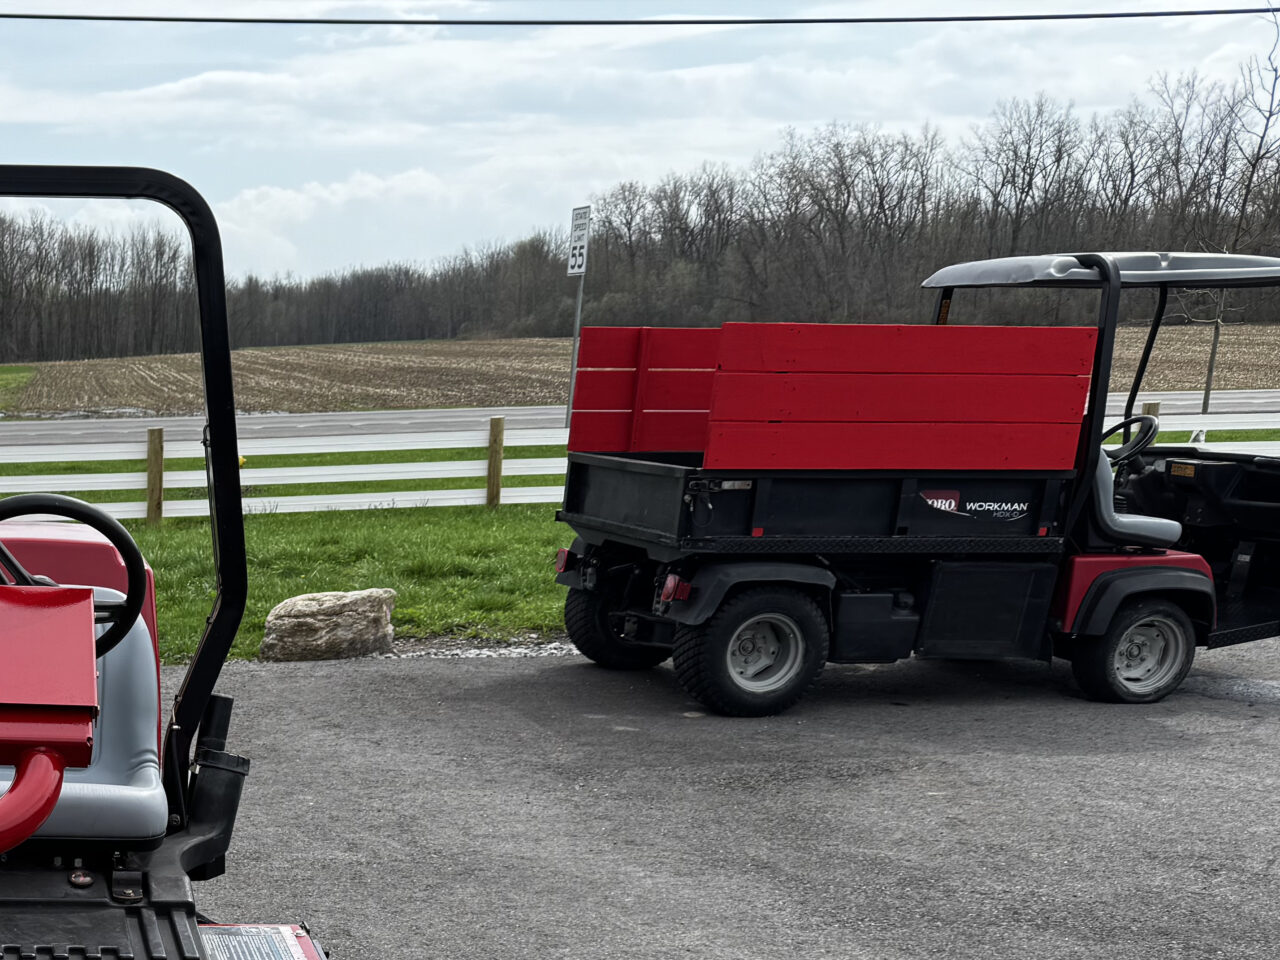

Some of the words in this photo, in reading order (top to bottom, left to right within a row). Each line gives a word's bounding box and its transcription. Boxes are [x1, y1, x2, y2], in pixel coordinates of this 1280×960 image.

[570, 245, 585, 270] 55
[926, 499, 956, 511] ORO
[966, 502, 1029, 511] WORKMAN
